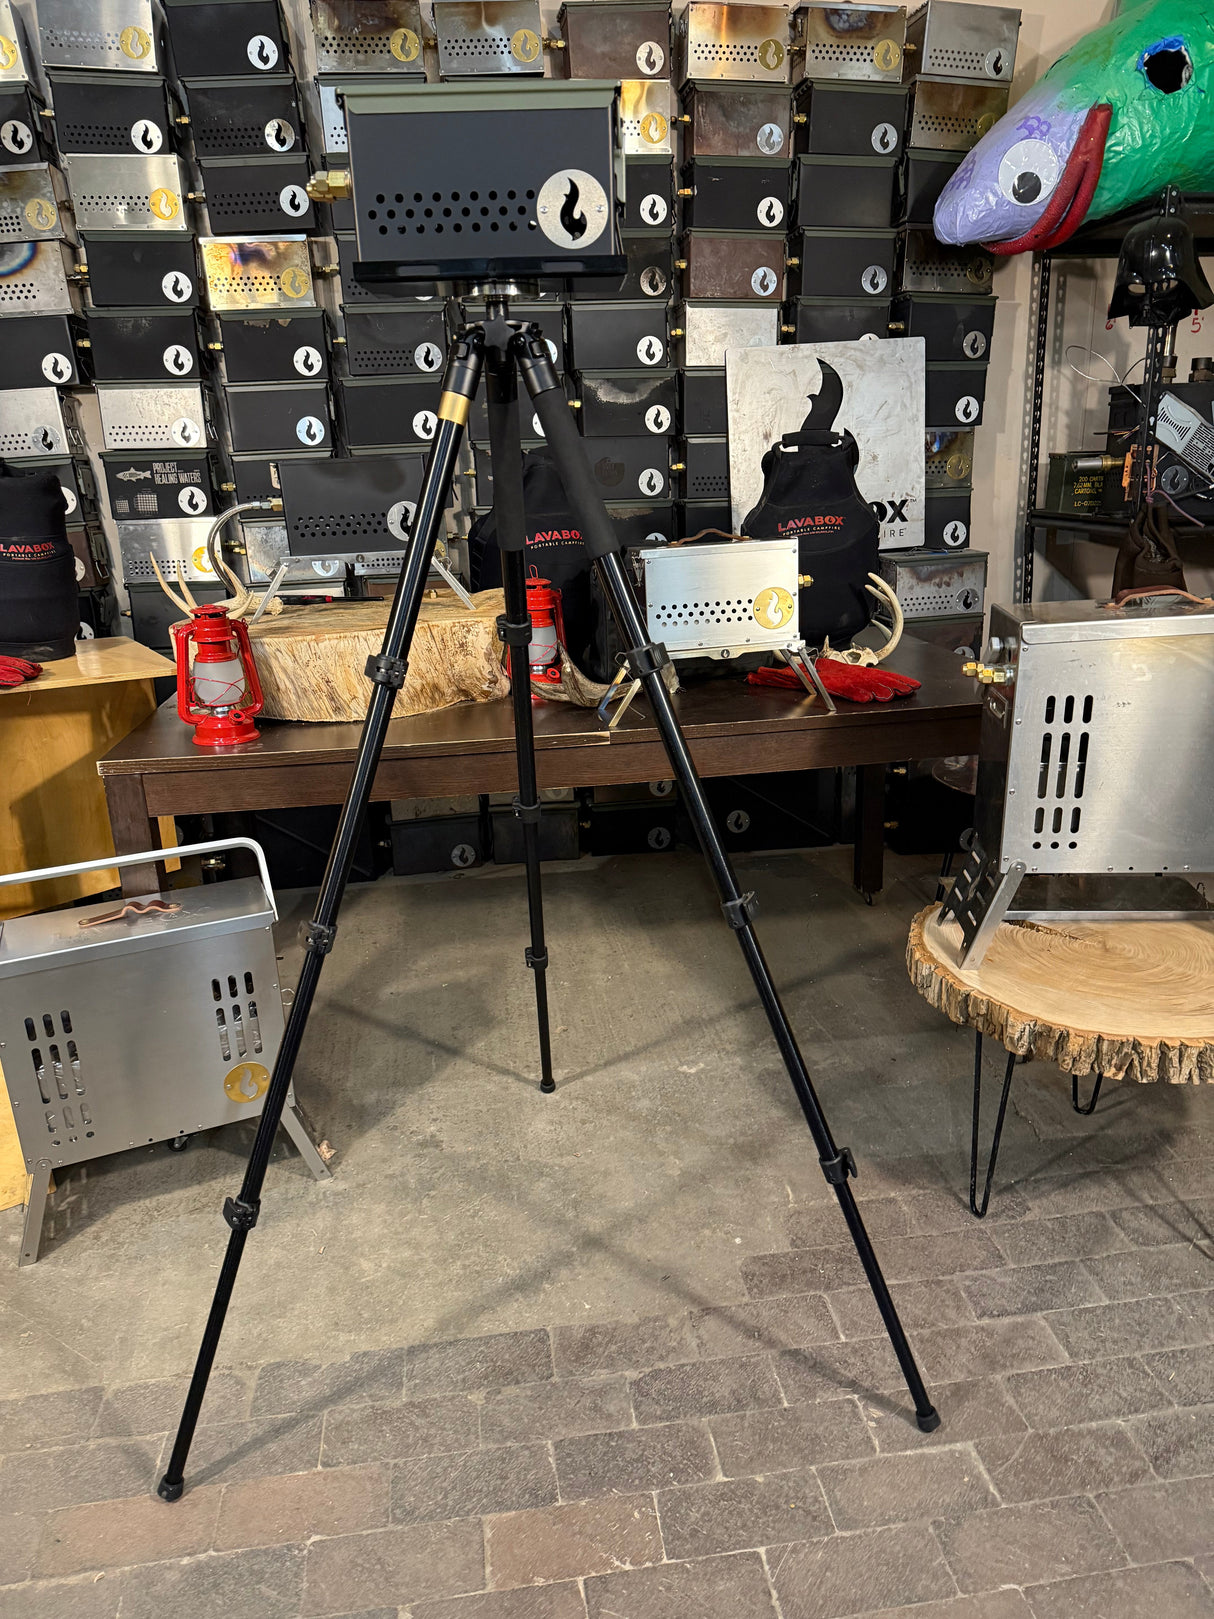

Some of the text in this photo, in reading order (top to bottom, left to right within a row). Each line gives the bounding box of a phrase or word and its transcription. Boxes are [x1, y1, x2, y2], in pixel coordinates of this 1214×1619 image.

[152, 462, 178, 474] PROJECT
[154, 472, 202, 485] HEALING WATERS
[777, 515, 844, 533] LAVABOX
[525, 529, 583, 546] LAVABO
[782, 527, 811, 537] PORTABLE
[0, 541, 55, 553] LAVABOX
[530, 542, 559, 550] PORTABLE
